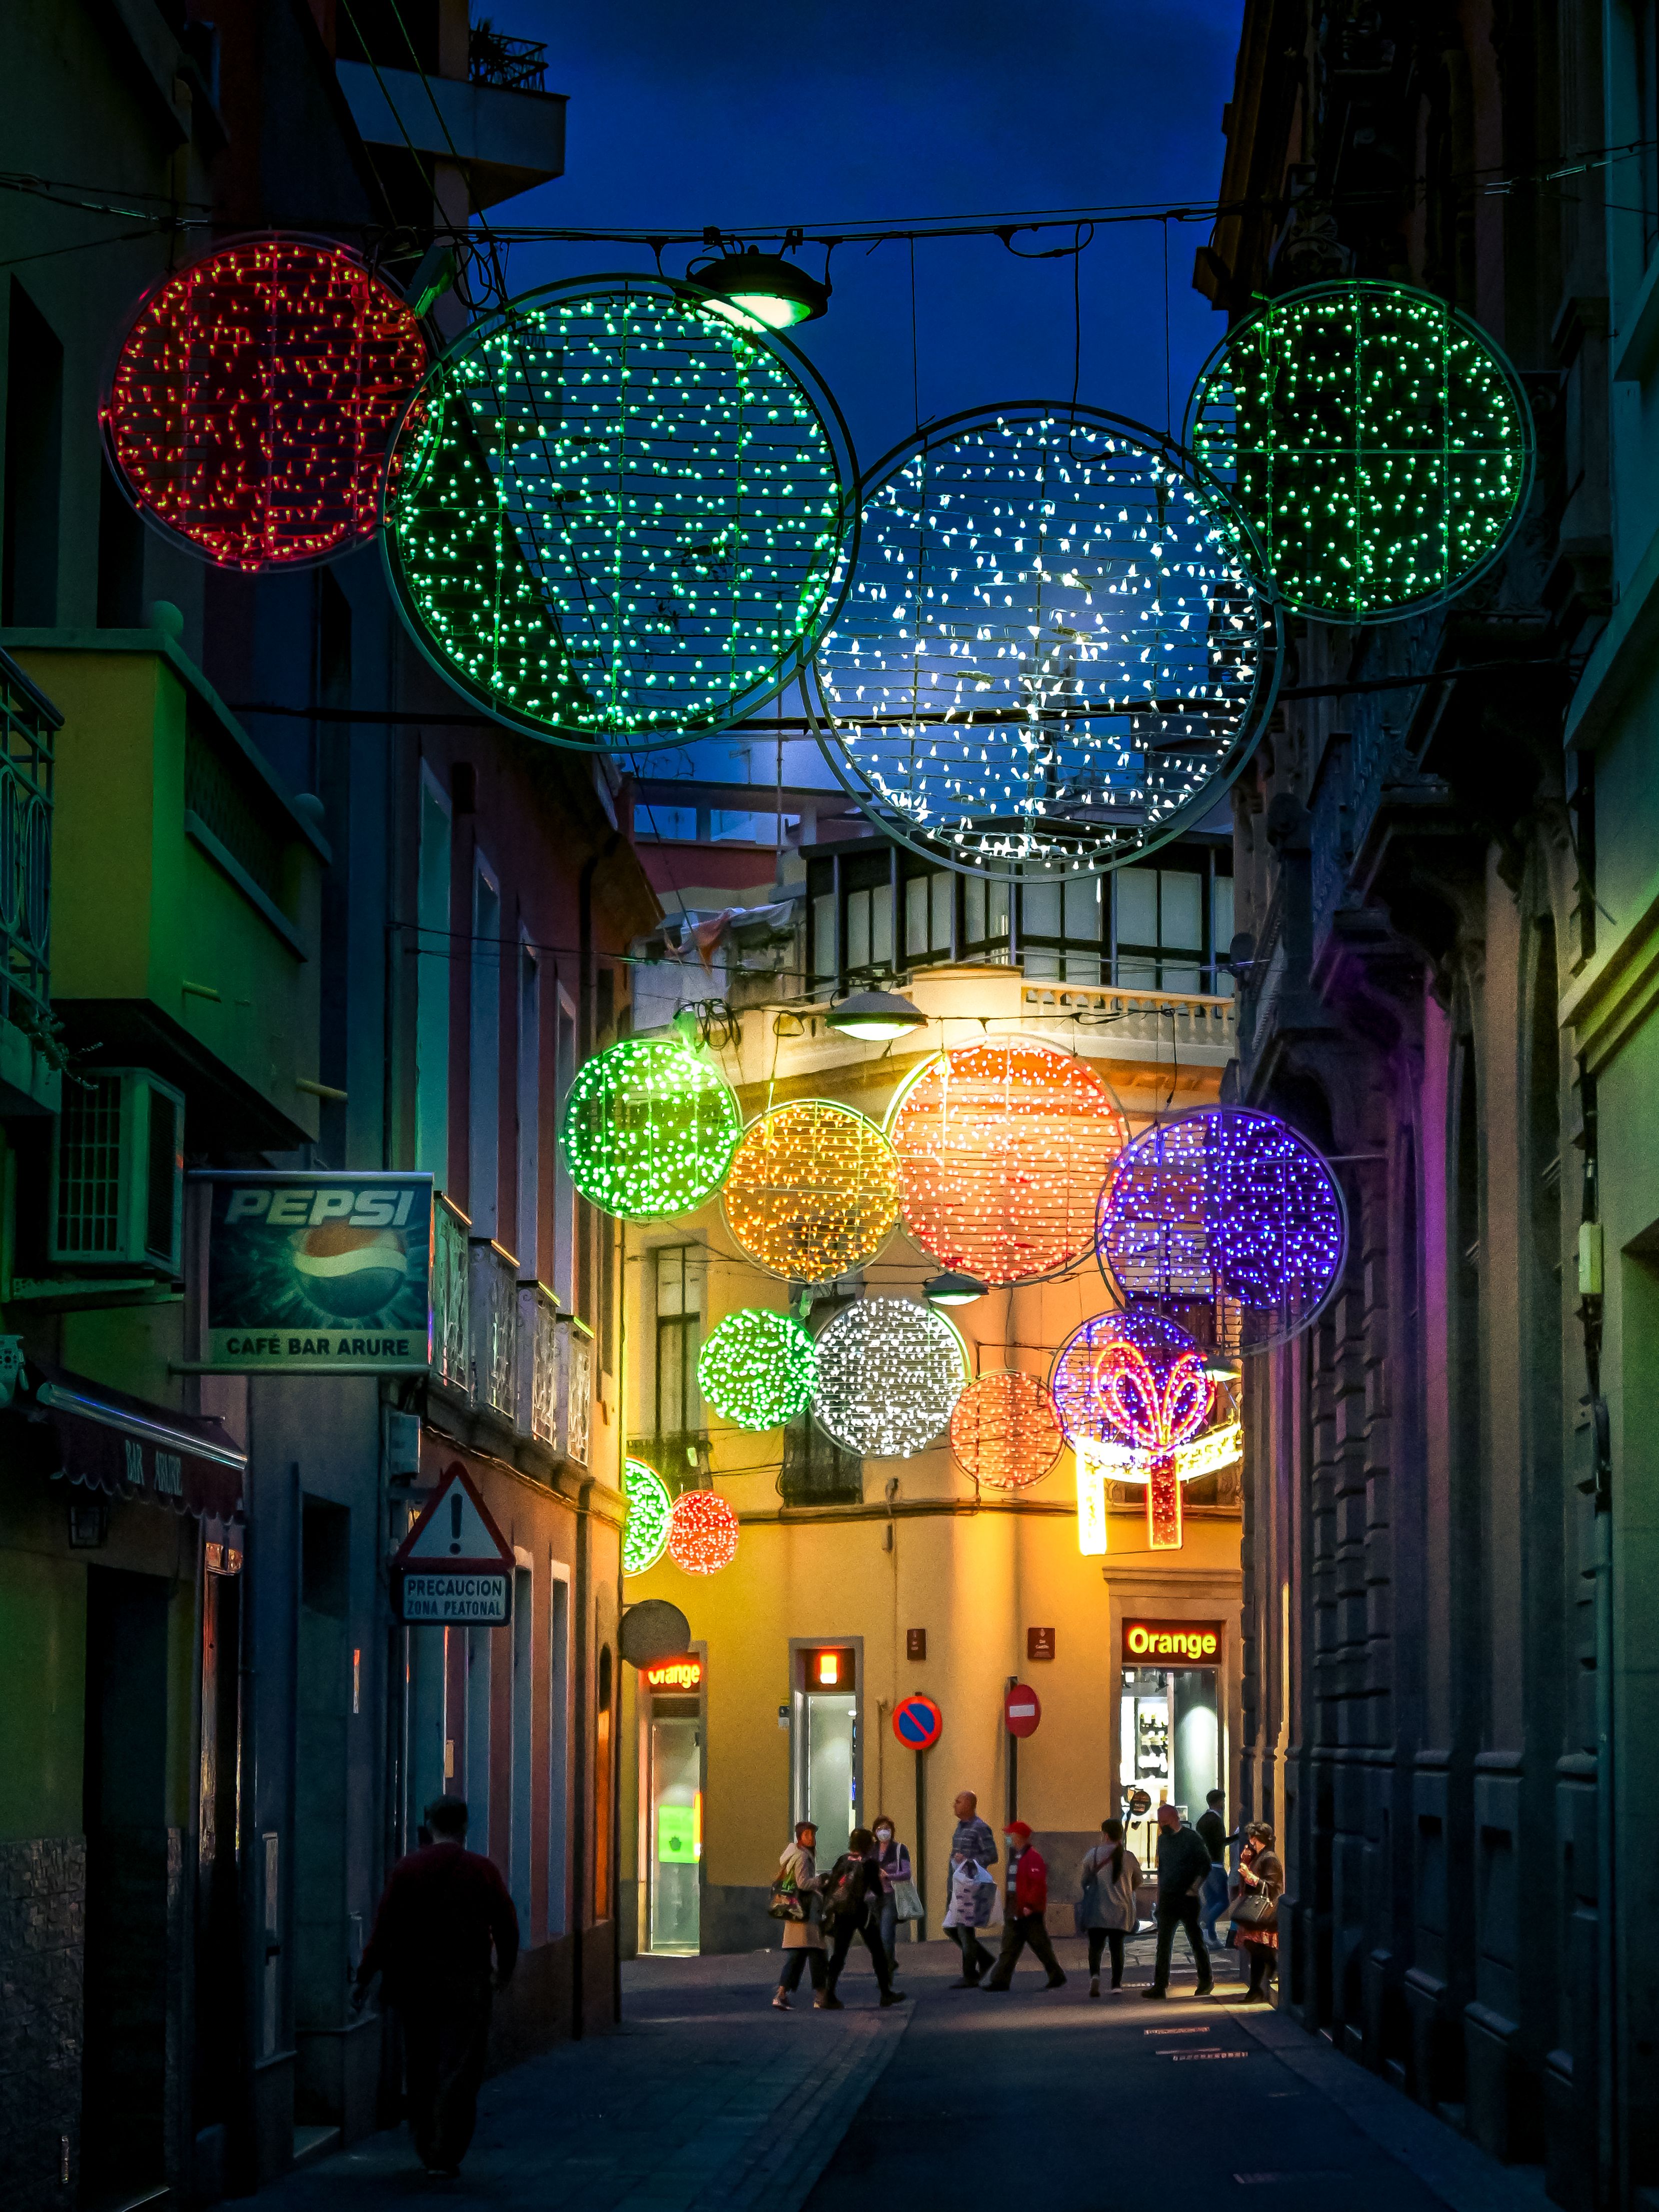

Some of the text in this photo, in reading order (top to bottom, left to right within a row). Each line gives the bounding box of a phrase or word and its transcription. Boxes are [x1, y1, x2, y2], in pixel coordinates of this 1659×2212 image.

[224, 1190, 415, 1226] PEPSI
[226, 1334, 410, 1357] CAFÉ BAR ARURE
[408, 1579, 502, 1597] PRECAUCION
[407, 1600, 502, 1616] ZONA PEATONAL
[1129, 1627, 1216, 1659] Orange
